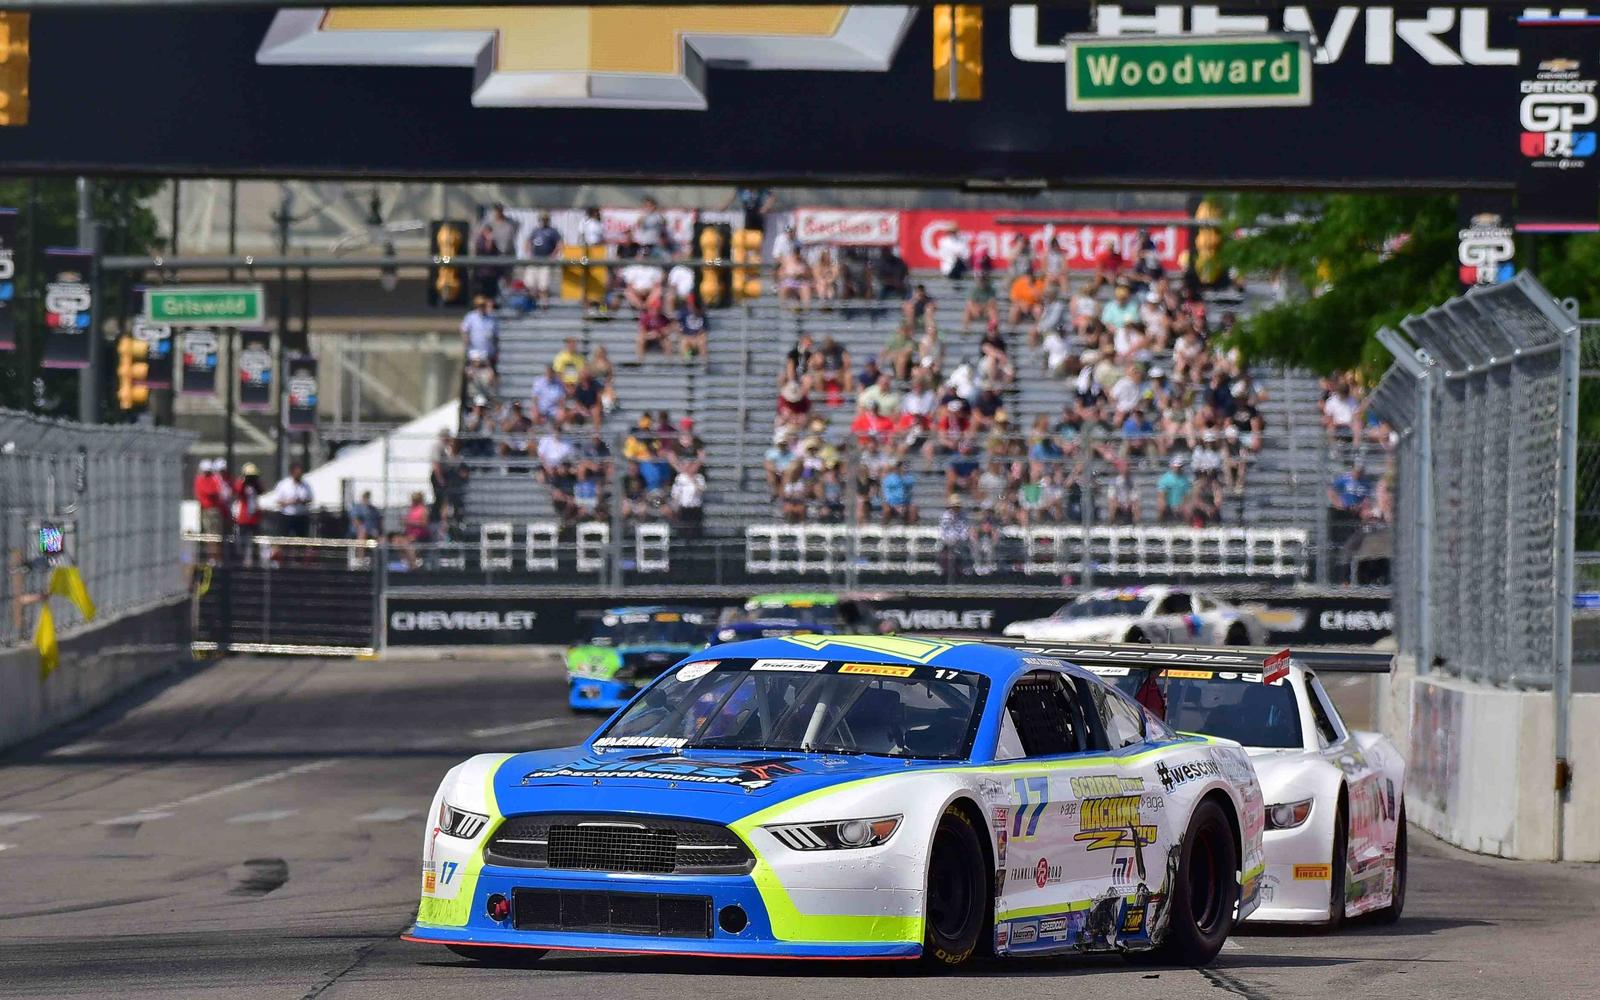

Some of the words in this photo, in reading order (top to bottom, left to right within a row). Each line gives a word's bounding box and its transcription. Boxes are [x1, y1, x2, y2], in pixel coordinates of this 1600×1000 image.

[1086, 53, 1292, 87] Woodward
[1520, 80, 1598, 94] DETROIT
[1519, 93, 1599, 132] GP
[163, 295, 247, 316] Griswold
[391, 611, 537, 630] CHEVROLET
[878, 612, 994, 632] VROLET
[846, 664, 910, 676] PIRELLI
[934, 669, 959, 680] 17
[592, 736, 688, 748] MACHAVERN
[1069, 775, 1121, 799] SCREEN
[1012, 775, 1048, 838] 17
[1080, 795, 1142, 831] MACHINE
[1146, 796, 1165, 813] aga
[440, 861, 459, 884] 17
[1011, 865, 1037, 882] FRANKLIN
[1295, 866, 1328, 878] PIRELLI
